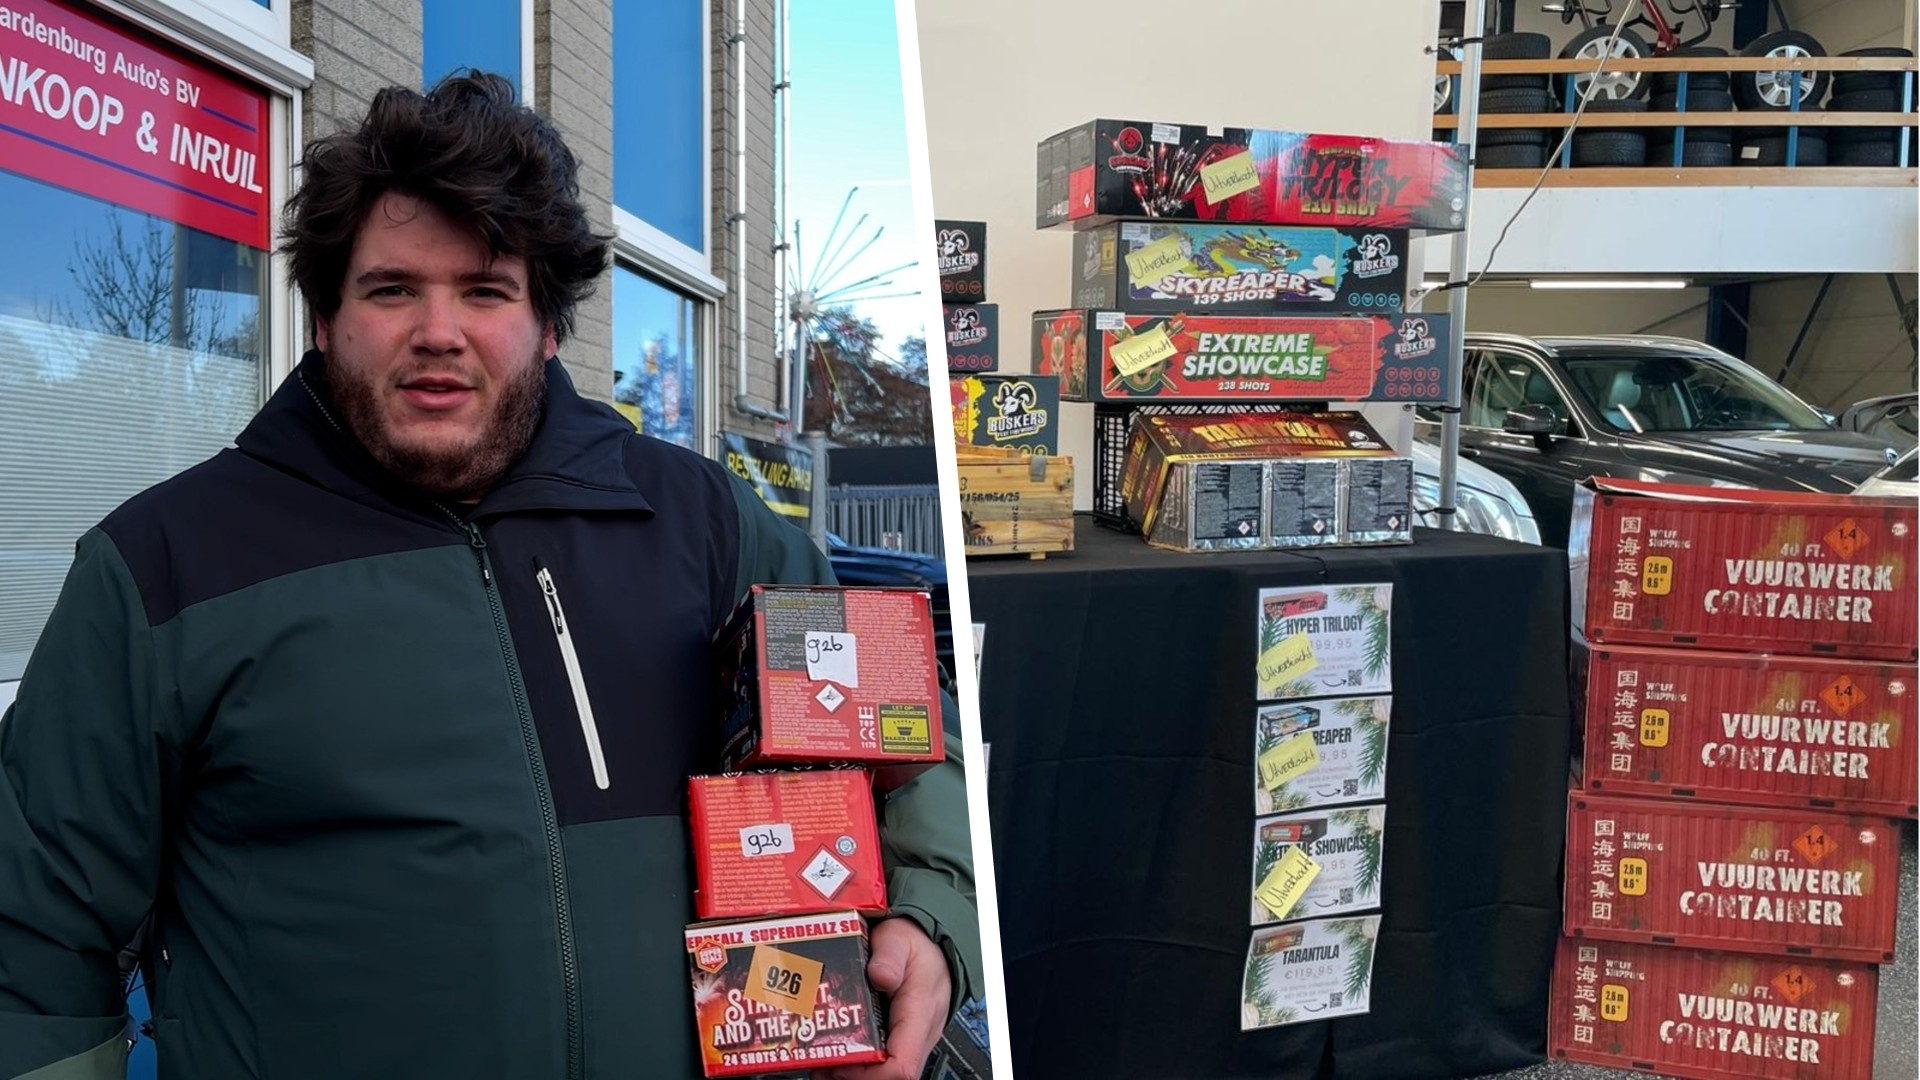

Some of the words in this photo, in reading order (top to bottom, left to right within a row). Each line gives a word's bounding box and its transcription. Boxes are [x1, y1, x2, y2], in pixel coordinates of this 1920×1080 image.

[113, 52, 170, 97] Auto's
[176, 78, 201, 108] BV
[136, 110, 159, 155] &
[169, 122, 263, 194] INRUIL
[1282, 175, 1408, 204] TRILOGY
[1301, 201, 1331, 214] 210
[1336, 202, 1379, 216] SHOT
[1160, 272, 1307, 294] SKYREAPER
[1193, 293, 1217, 306] 139
[1222, 288, 1276, 303] SHOTS
[1198, 332, 1311, 353] EXTREME
[1182, 354, 1325, 376] SHOWCASE
[1218, 381, 1237, 391] 238
[1239, 381, 1270, 392] SHOTS
[989, 411, 1045, 432] BUSKERS
[1192, 419, 1341, 442] TARANTULA
[1838, 527, 1858, 540] 1.4
[1804, 543, 1826, 558] FT.
[1725, 558, 1895, 592] VUURWERK
[1703, 588, 1874, 623] CONTAINER
[1286, 617, 1320, 634] HYPER
[1322, 614, 1365, 632] TRILOGY
[1833, 684, 1853, 697] 1.4
[1800, 699, 1821, 714] FT.
[1721, 712, 1891, 748] VUURWERK
[861, 741, 877, 749] 1170
[1700, 742, 1870, 780] CONTAINER
[1805, 833, 1825, 846] 1.4
[1774, 848, 1795, 863] FT.
[1697, 861, 1864, 896] VUURWERK
[1679, 890, 1844, 926] CONTAINER
[749, 921, 838, 943] SUPERDEALZ
[1282, 944, 1340, 966] TARANTULA
[766, 965, 803, 996] 926
[1785, 972, 1803, 985] 1.4
[1754, 984, 1773, 999] FT.
[713, 1019, 752, 1047] AND
[755, 1015, 792, 1040] THE
[797, 1004, 863, 1043] BEAST
[1677, 993, 1840, 1036] VUURWERK
[1659, 1020, 1820, 1064] CONTAINER
[723, 1053, 738, 1067] 24
[740, 1049, 777, 1065] SHOTS
[779, 1048, 790, 1060] &
[792, 1048, 807, 1061] 13
[808, 1044, 848, 1060] SHOTS
